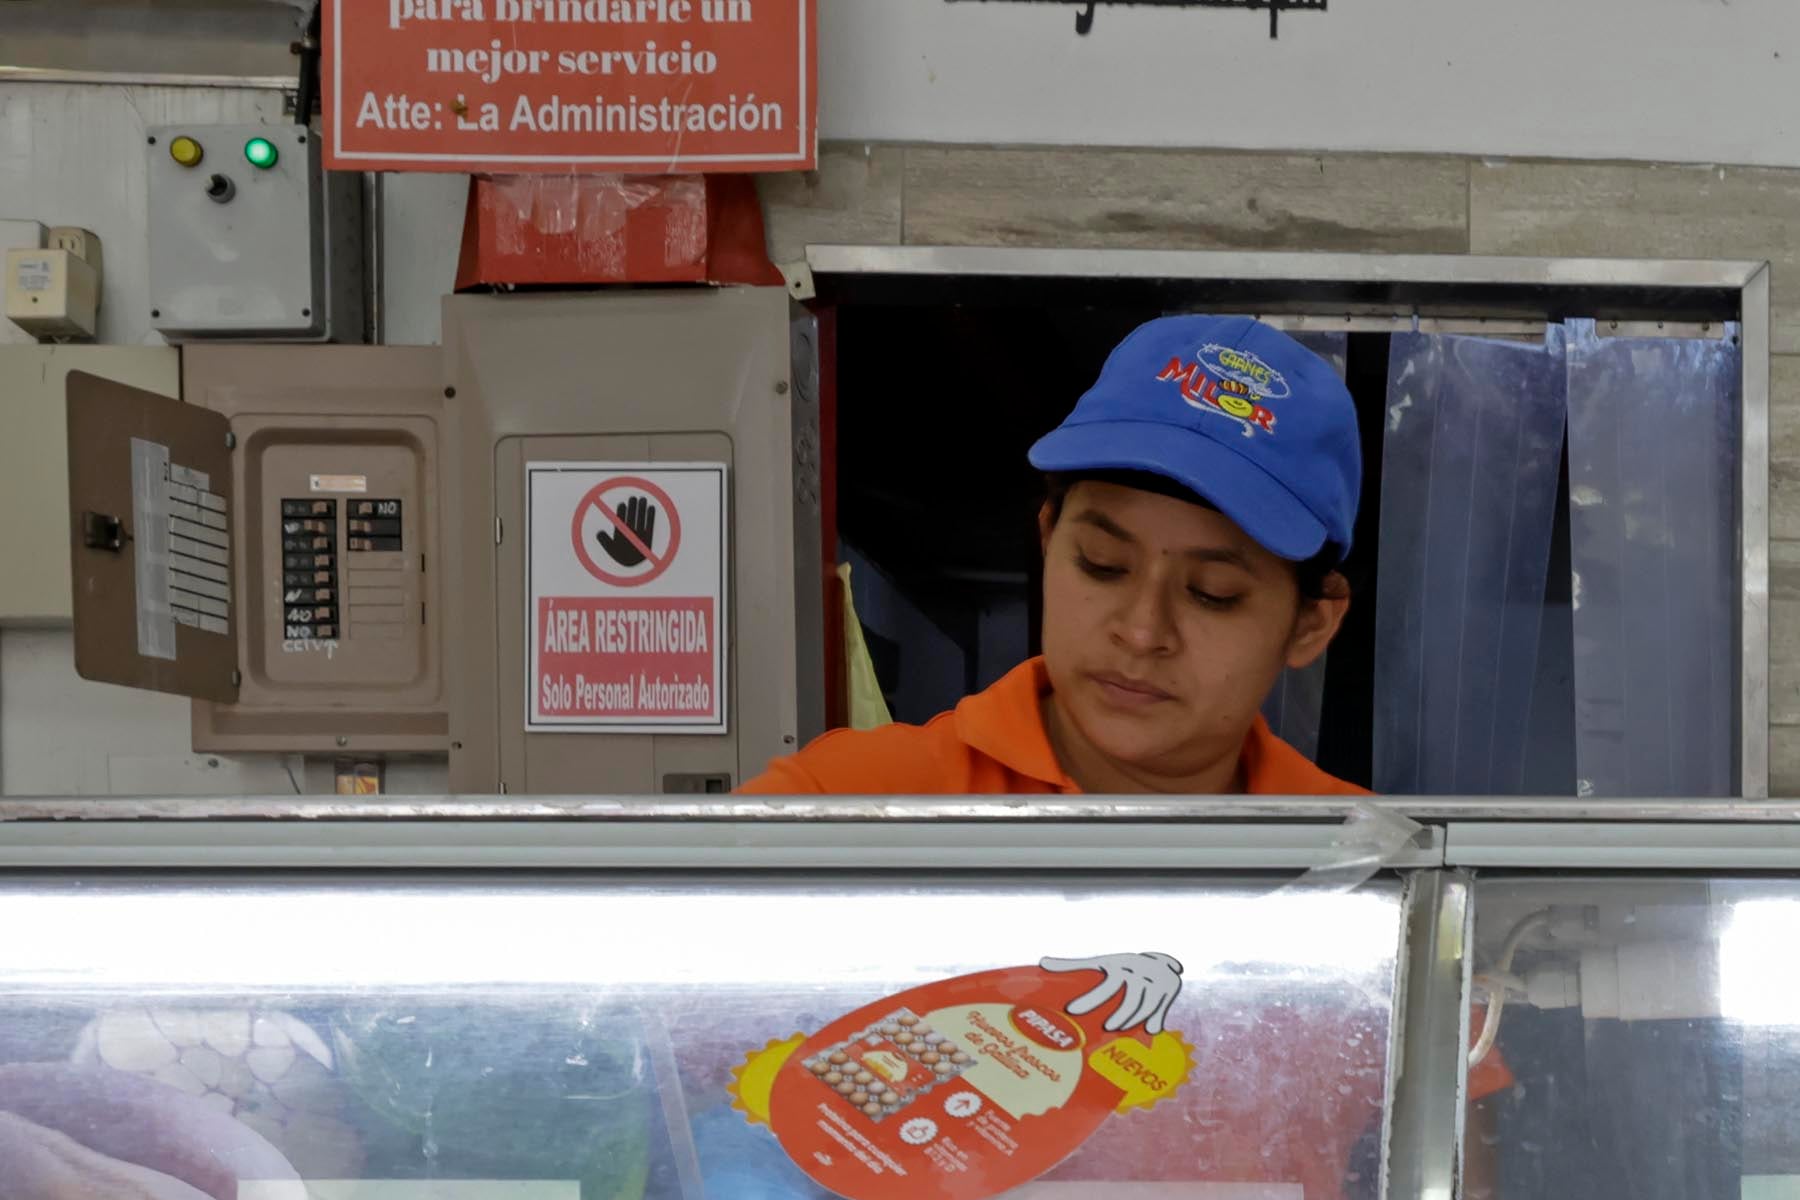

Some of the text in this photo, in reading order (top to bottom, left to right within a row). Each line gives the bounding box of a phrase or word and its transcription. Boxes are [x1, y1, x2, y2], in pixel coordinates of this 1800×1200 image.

[389, 0, 485, 29] para
[701, 0, 752, 22] un
[427, 40, 716, 82] mejor servicio
[356, 92, 782, 132] Atte: La Administración
[544, 599, 707, 653] ÁREA RESTRINGIDA
[543, 672, 709, 710] Solo Personal Autorizado
[1018, 1009, 1074, 1048] PIPASA
[1102, 1046, 1167, 1091] NUEVOS
